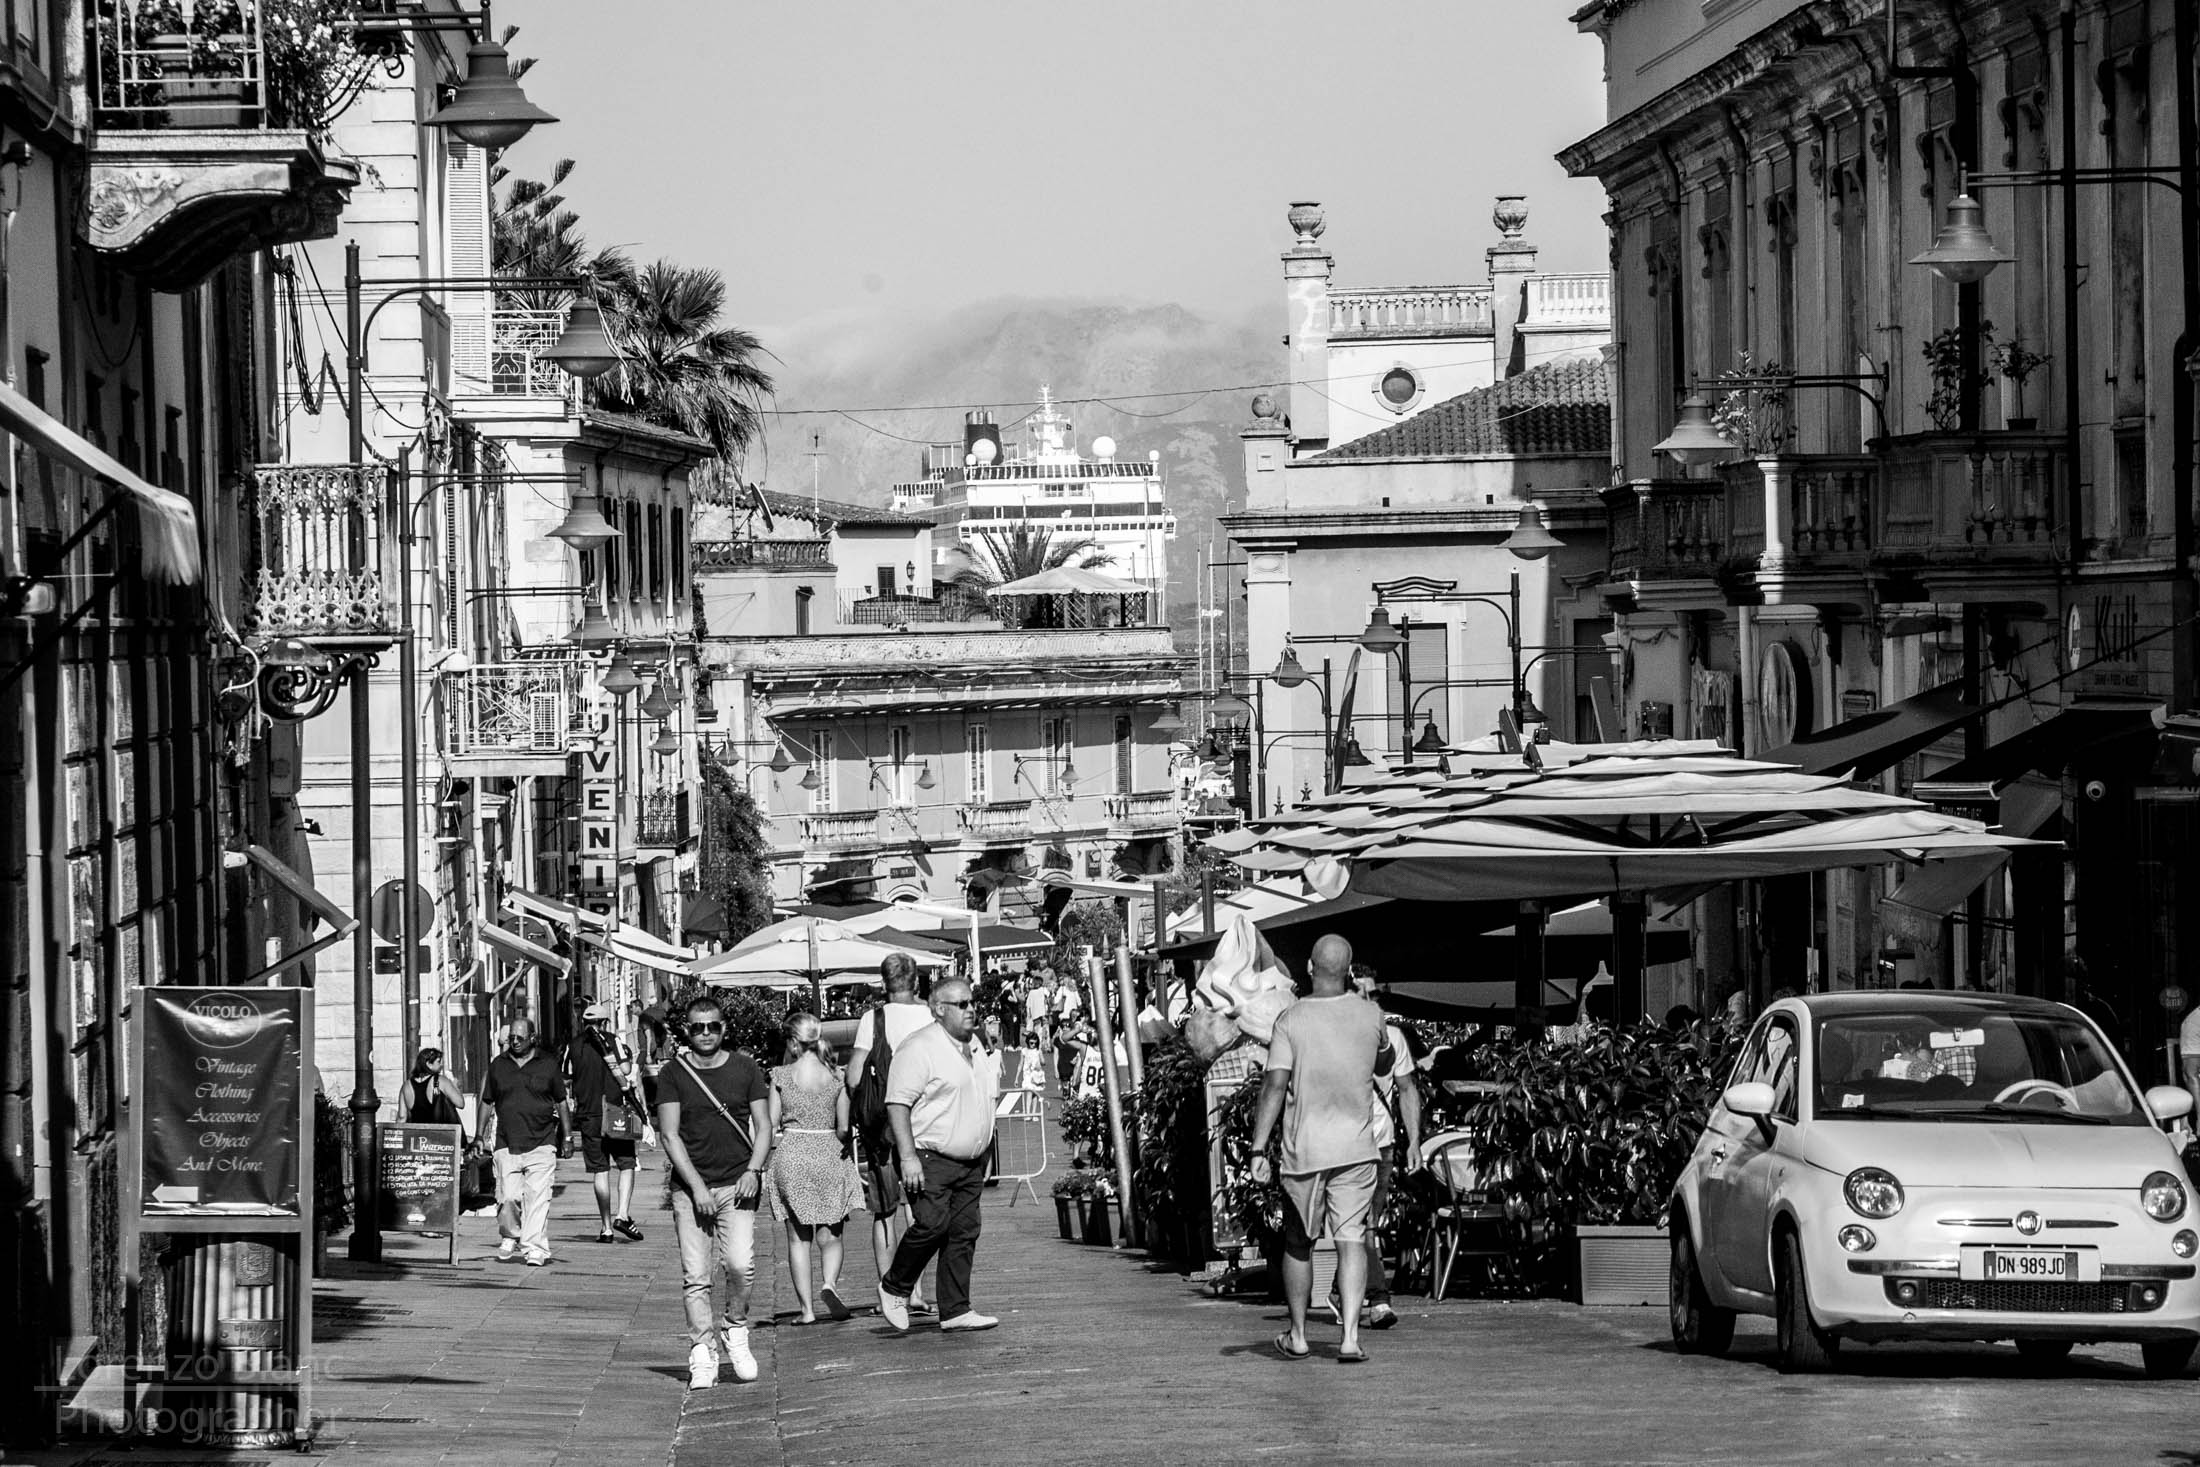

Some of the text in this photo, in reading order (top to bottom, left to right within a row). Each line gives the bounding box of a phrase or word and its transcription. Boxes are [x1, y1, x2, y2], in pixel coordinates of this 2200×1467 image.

[2095, 594, 2139, 662] Kult
[586, 651, 611, 917] VENIR
[194, 1006, 251, 1018] VICOLO
[194, 1056, 258, 1079] Vintage
[194, 1082, 255, 1104] Clothing
[186, 1107, 261, 1123] Accessories
[199, 1131, 251, 1152] Objects
[176, 1157, 213, 1172] And
[1997, 1256, 2015, 1274] DN
